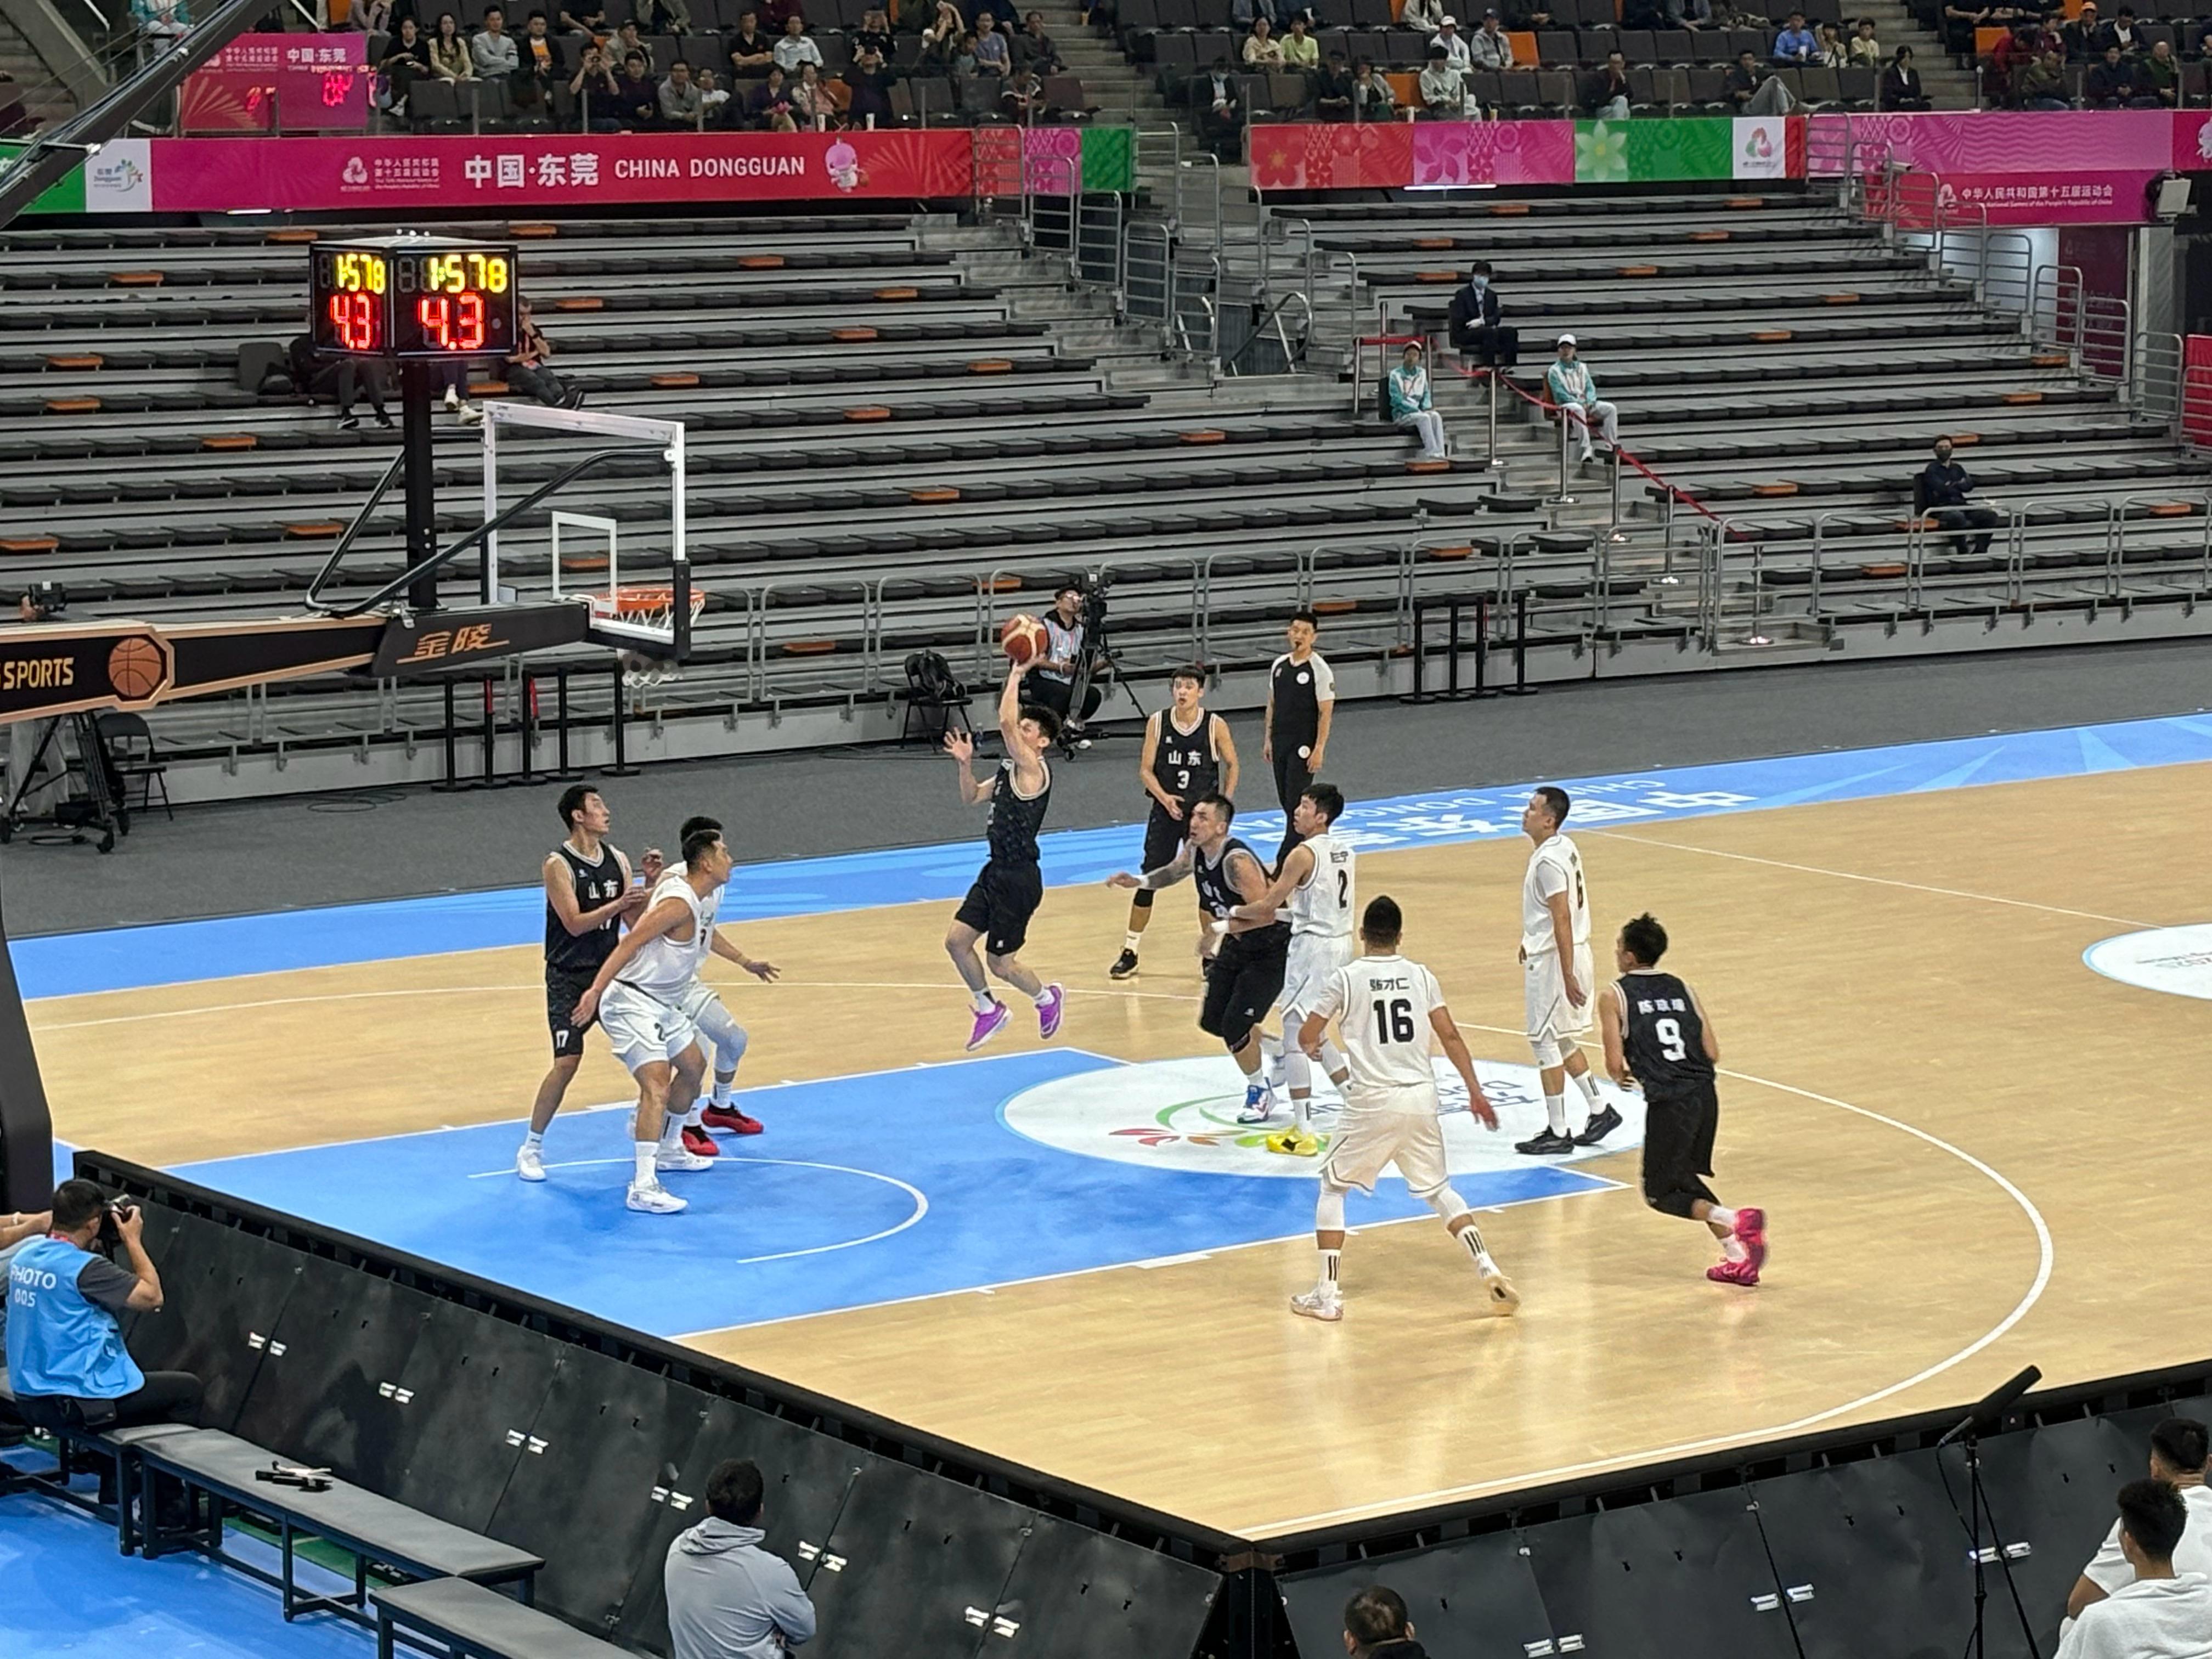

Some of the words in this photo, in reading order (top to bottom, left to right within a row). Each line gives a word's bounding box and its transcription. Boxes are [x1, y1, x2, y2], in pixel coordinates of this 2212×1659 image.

[465, 153, 599, 189] 中国·东莞
[615, 159, 680, 178] CHINA
[690, 157, 805, 177] DONGGUAN
[419, 292, 484, 351] 4.3
[1168, 749, 1203, 766] 山东
[1177, 770, 1190, 789] 3
[1338, 870, 1348, 909] 2
[1373, 998, 1414, 1043] 16
[556, 1030, 569, 1049] 17
[1655, 1018, 1686, 1061] 9
[10, 1264, 57, 1290] PHOTO
[15, 1288, 37, 1307] 005
